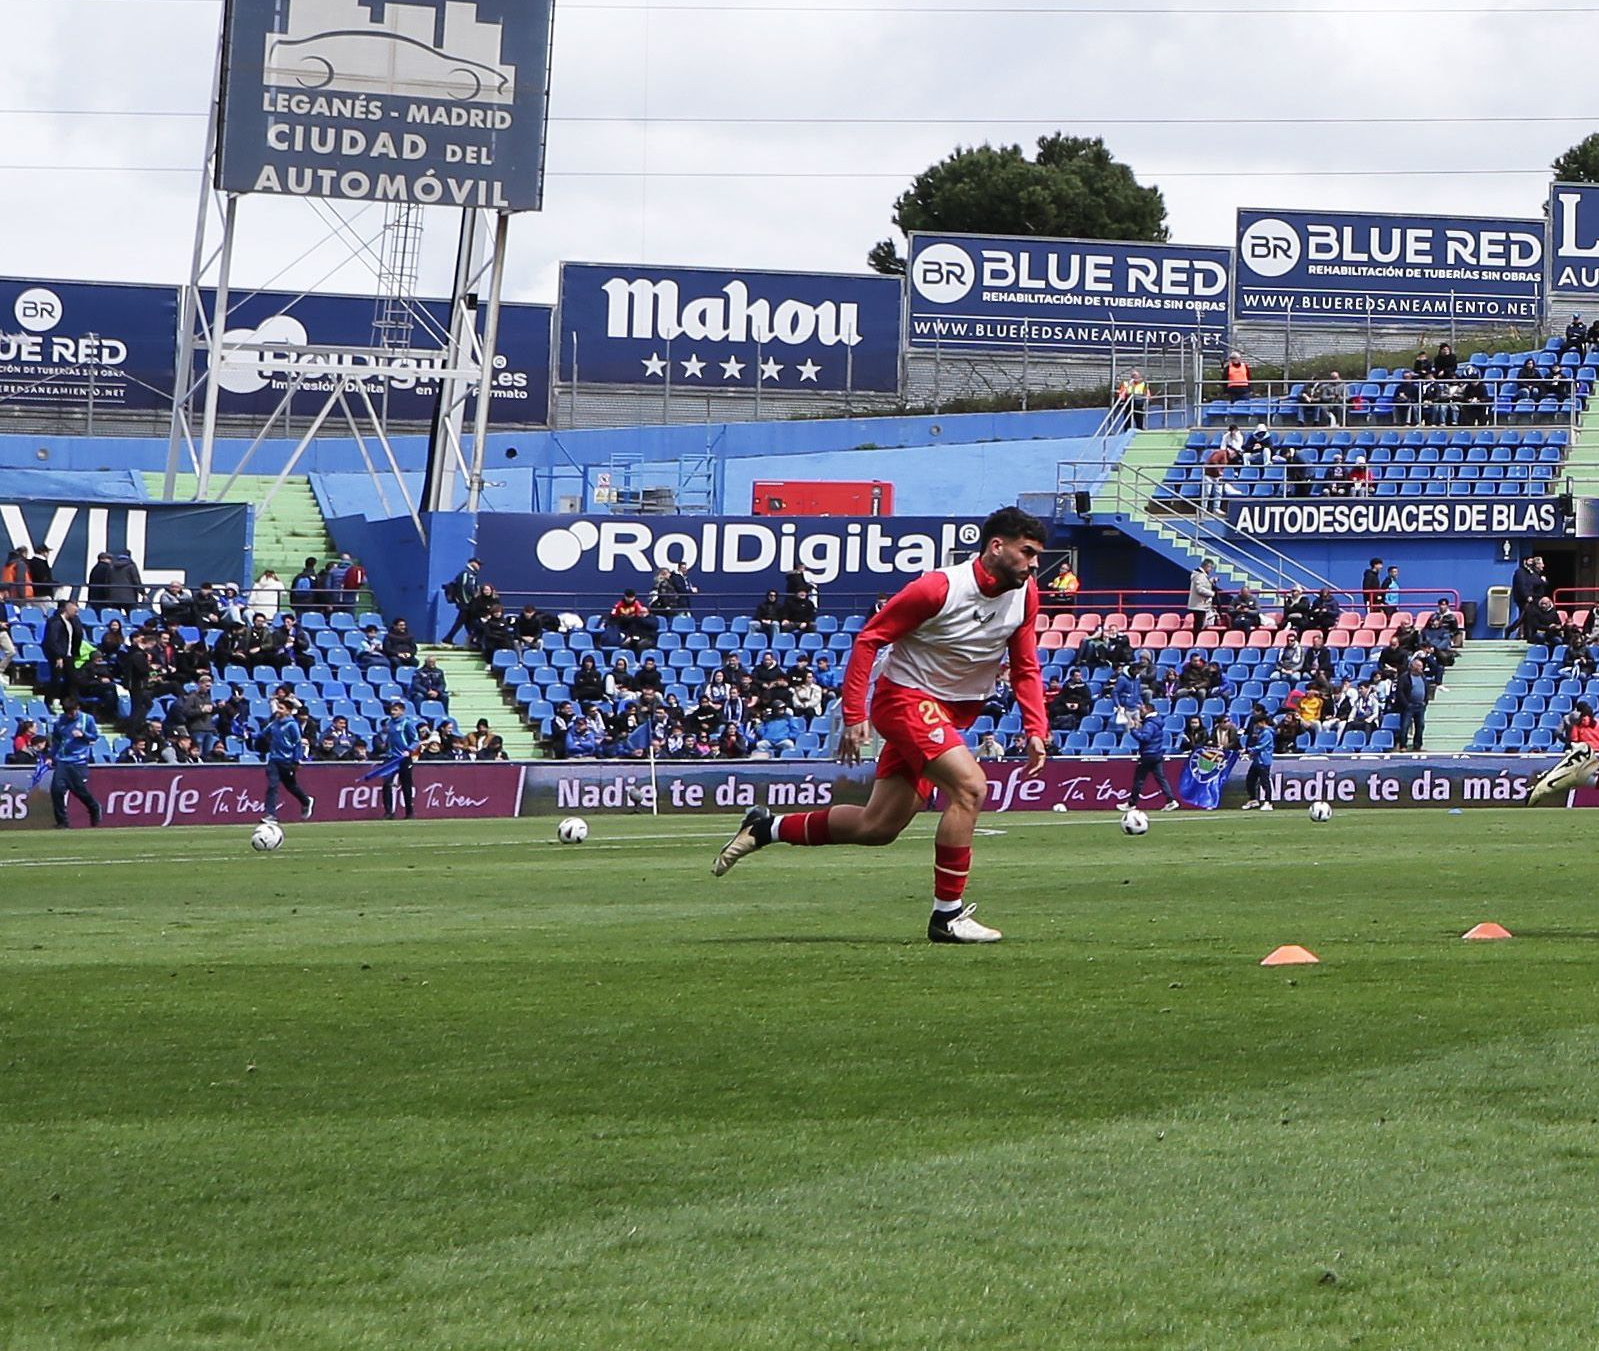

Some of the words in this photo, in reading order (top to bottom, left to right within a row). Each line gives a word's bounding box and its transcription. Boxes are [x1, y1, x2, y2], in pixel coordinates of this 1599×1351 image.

[263, 92, 382, 121] LEGANÉS
[407, 104, 513, 130] MADRID
[268, 124, 427, 160] CIUDAD
[446, 145, 492, 165] DEL
[254, 164, 509, 207] AUTOMÓVIL
[1250, 235, 1293, 259] BR
[1307, 224, 1433, 264] BLUE
[1445, 230, 1542, 267] RED
[921, 261, 967, 285] BR
[981, 250, 1114, 291] BLUE
[1126, 257, 1227, 296] RED
[1308, 264, 1403, 278] REHABILITACIÓN
[1406, 268, 1421, 278] DE
[1424, 267, 1480, 280] TUBERÍAS
[1481, 270, 1501, 280] SIN
[1503, 271, 1541, 282] OBRAS
[23, 302, 56, 319] BR
[603, 277, 862, 347] Mahou
[982, 291, 1082, 305] REHABILITACIÓN
[1084, 297, 1101, 306] DE
[1103, 296, 1161, 309] TUBERÍAS
[1163, 300, 1184, 310] SIN
[1185, 301, 1226, 312] OBRAS
[52, 338, 127, 365] RED
[1236, 504, 1448, 534] AUTODESGUACES
[1455, 504, 1487, 532] DE
[1492, 503, 1555, 531] BLAS
[600, 523, 957, 584] RolDigital
[107, 775, 199, 826] renfe
[209, 787, 233, 815] Tu
[423, 782, 443, 808] Tu
[445, 785, 488, 808] tren
[670, 777, 704, 806] te
[715, 776, 754, 806] da
[768, 775, 832, 805] más
[1058, 777, 1090, 800] Tu
[1368, 773, 1399, 800] te
[1412, 771, 1449, 799] da
[1463, 770, 1528, 799] más
